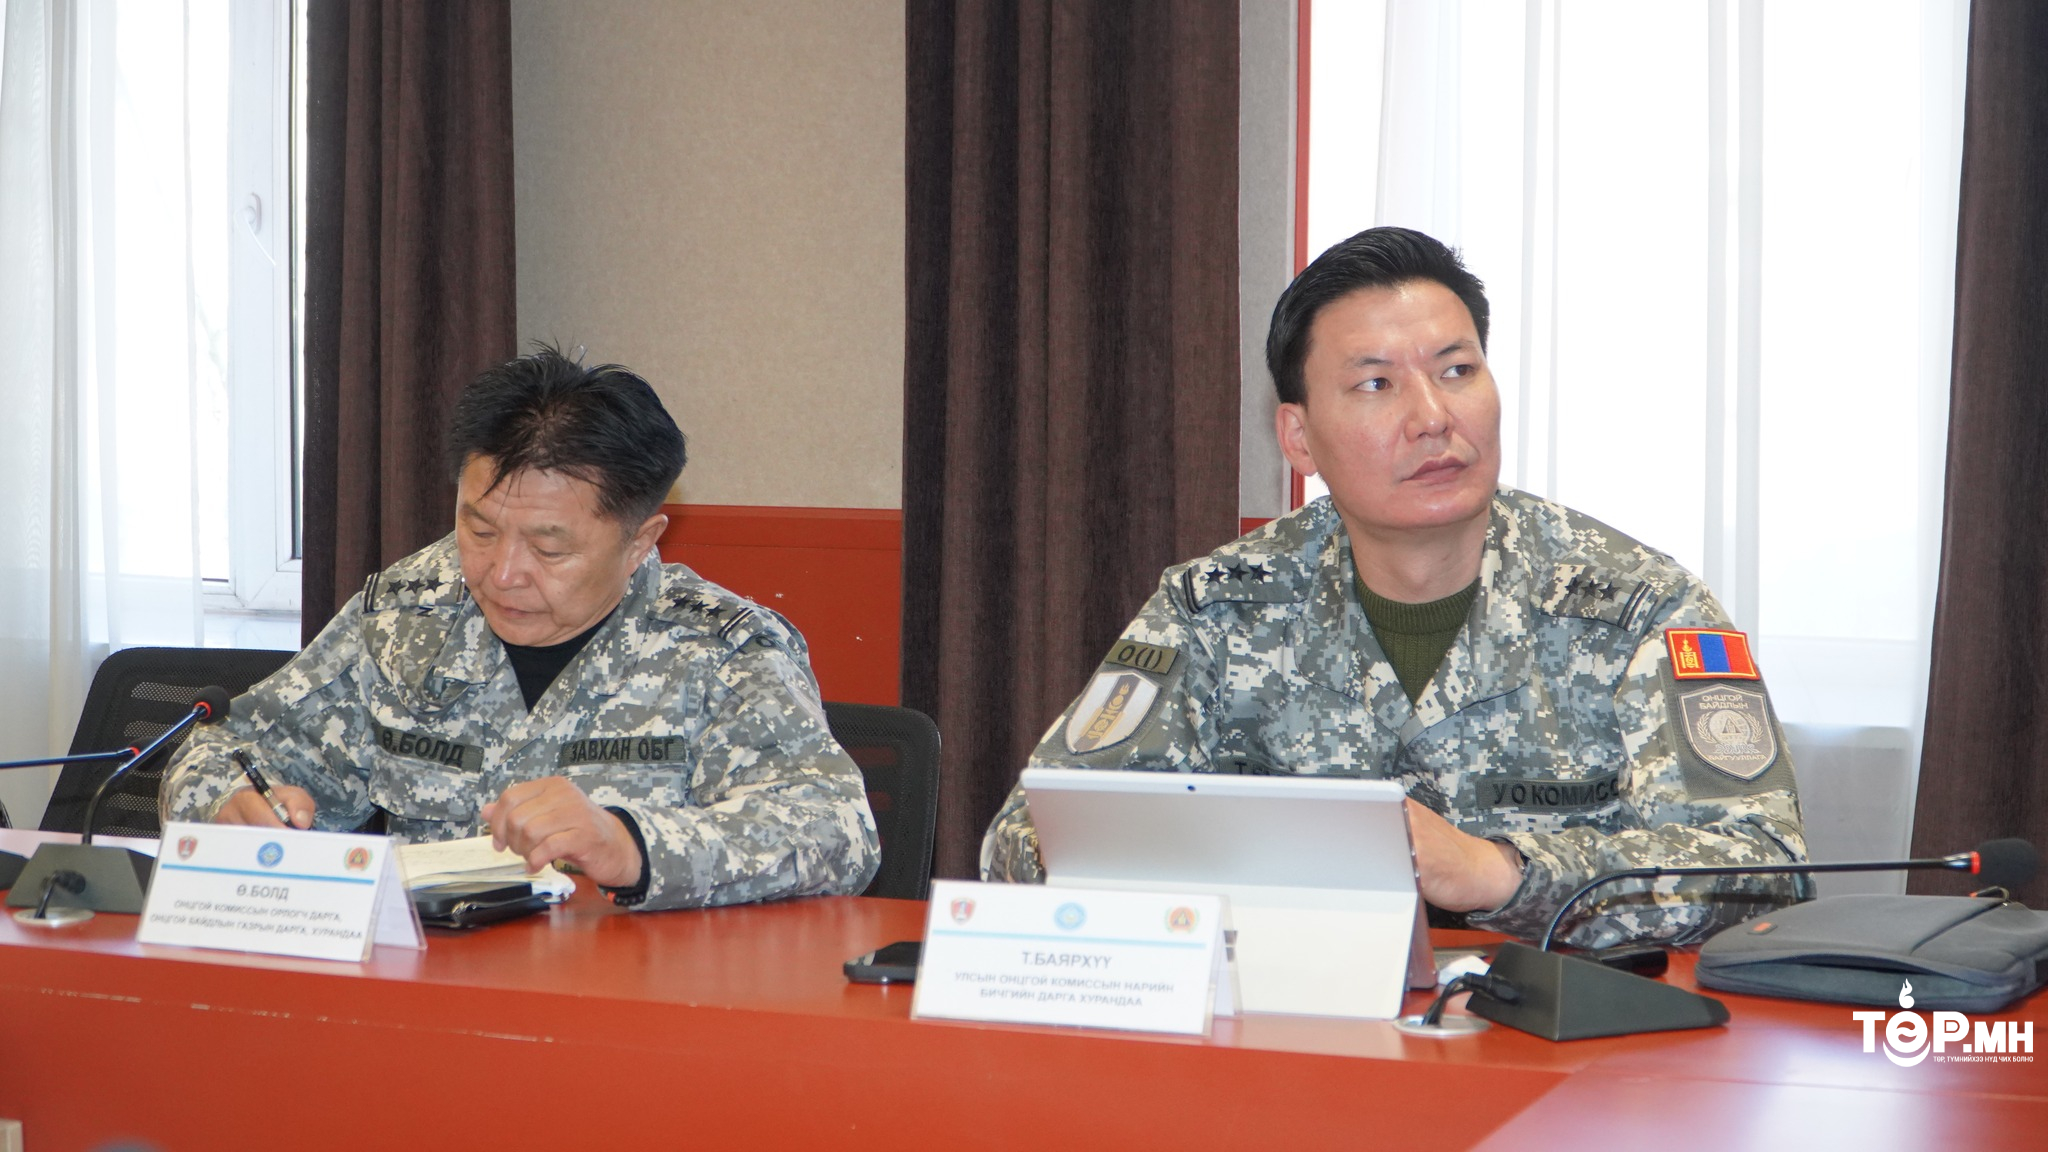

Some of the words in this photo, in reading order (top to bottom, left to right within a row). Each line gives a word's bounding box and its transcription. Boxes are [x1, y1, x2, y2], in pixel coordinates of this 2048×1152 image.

[1699, 702, 1749, 710] БАЙДЛЫН
[1702, 694, 1743, 703] ОНЦГОЙ
[382, 728, 466, 769] Ө.БОЛД
[570, 738, 631, 762] ЗАВХАН
[638, 738, 675, 761] ОБГ
[236, 884, 289, 901] Ө.БОЛД
[174, 900, 212, 911] ОНЦГОЙ
[214, 903, 269, 916] КОМИССЫН
[270, 907, 308, 918] ОРЛОГЧ
[150, 913, 187, 924] ОНЦГОЙ
[188, 917, 235, 929] БАЙДЛЫН
[236, 921, 275, 933] ГАЗРЫН
[312, 928, 362, 940] ХУРАНДАА
[1022, 951, 1112, 970] Т.БАЯРХҮҮ
[955, 972, 996, 983] УЛСЫН
[999, 974, 1048, 987] ОНЦГОЙ
[1051, 977, 1121, 990] КОМИССЫН
[1124, 981, 1174, 993] НАРИЙН
[980, 988, 1035, 1000] БИЧГИЙН
[1037, 992, 1076, 1004] ДАРГА
[1080, 994, 1143, 1008] ХУРАНДАА
